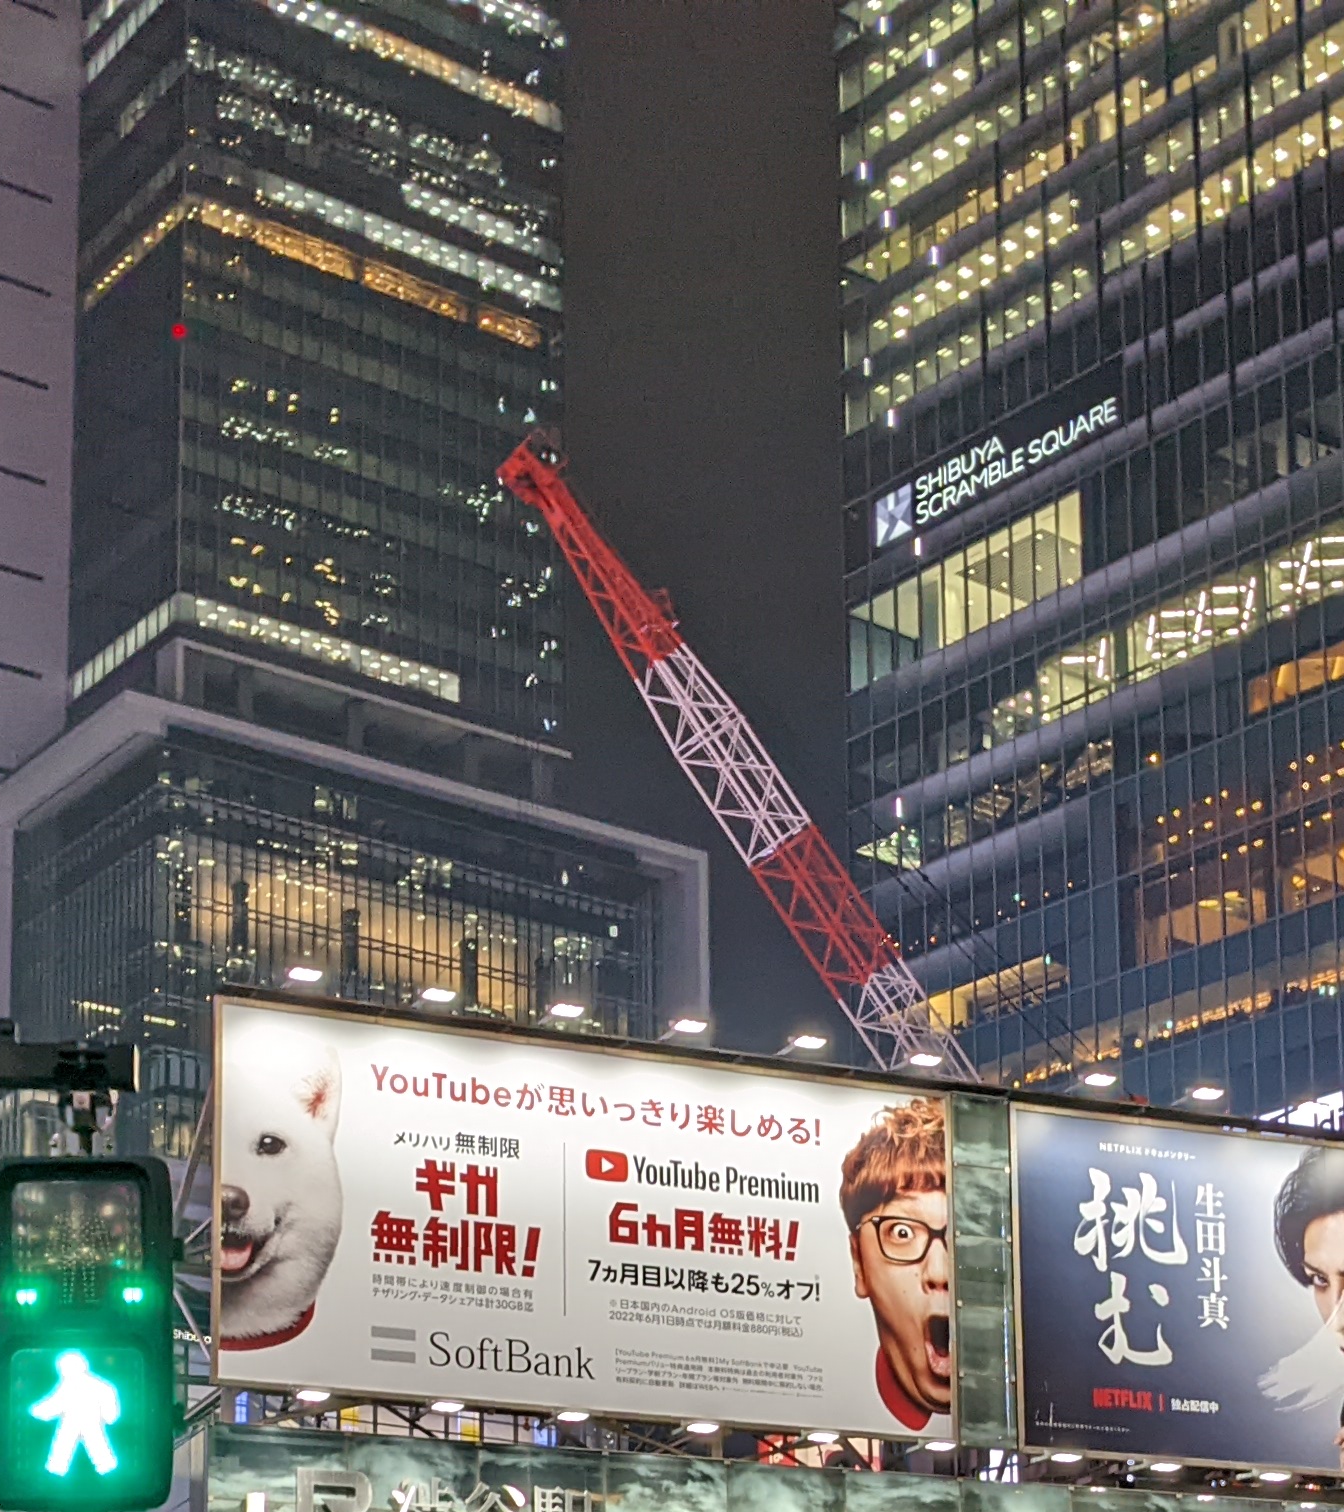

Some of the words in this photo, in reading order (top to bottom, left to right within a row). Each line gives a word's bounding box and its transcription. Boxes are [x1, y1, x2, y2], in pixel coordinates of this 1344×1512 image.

[915, 448, 1025, 525] SCRAMBLE
[1027, 396, 1119, 465] SQUARE
[915, 436, 1005, 500] SHIBUYA
[393, 1131, 520, 1160] メリハリ無制限
[1099, 1142, 1142, 1156] NETFLIX
[415, 1158, 499, 1218] ギガ
[632, 1155, 720, 1192] YouTube
[725, 1166, 820, 1204] Premium
[370, 1211, 542, 1279] 無制限!
[1073, 1167, 1188, 1366] 挑む
[1194, 1183, 1230, 1329] 生田斗真
[428, 1330, 596, 1381] SoftBank
[1093, 1388, 1153, 1411] NETFLIX
[1170, 1397, 1220, 1414] 独占配信中
